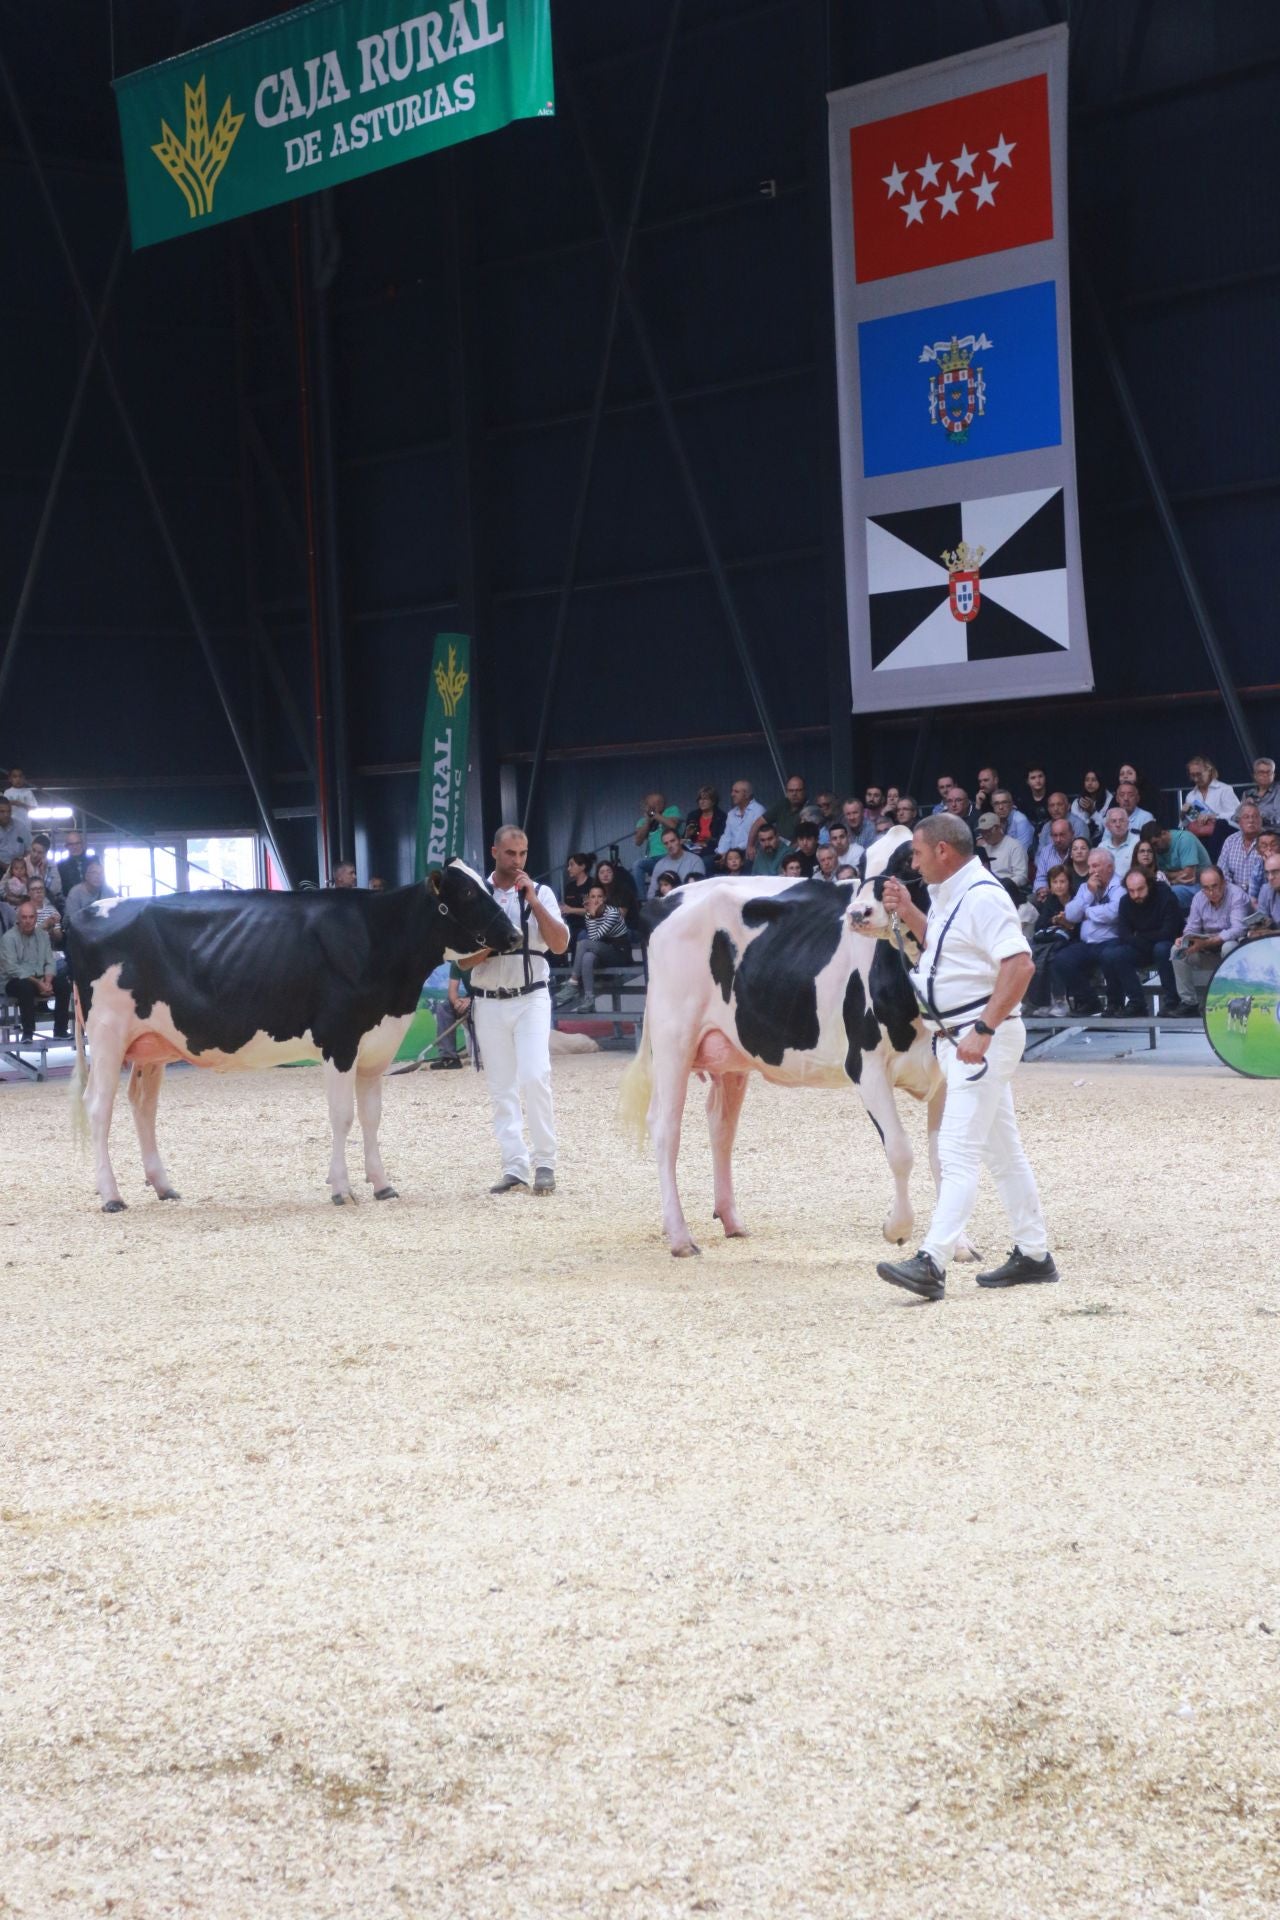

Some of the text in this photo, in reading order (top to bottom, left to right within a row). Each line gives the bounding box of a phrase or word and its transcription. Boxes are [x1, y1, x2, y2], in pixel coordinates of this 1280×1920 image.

[254, 0, 504, 128] CAJA RURAL
[285, 73, 477, 174] DE ASTURIAS
[426, 728, 452, 867] RURAL
